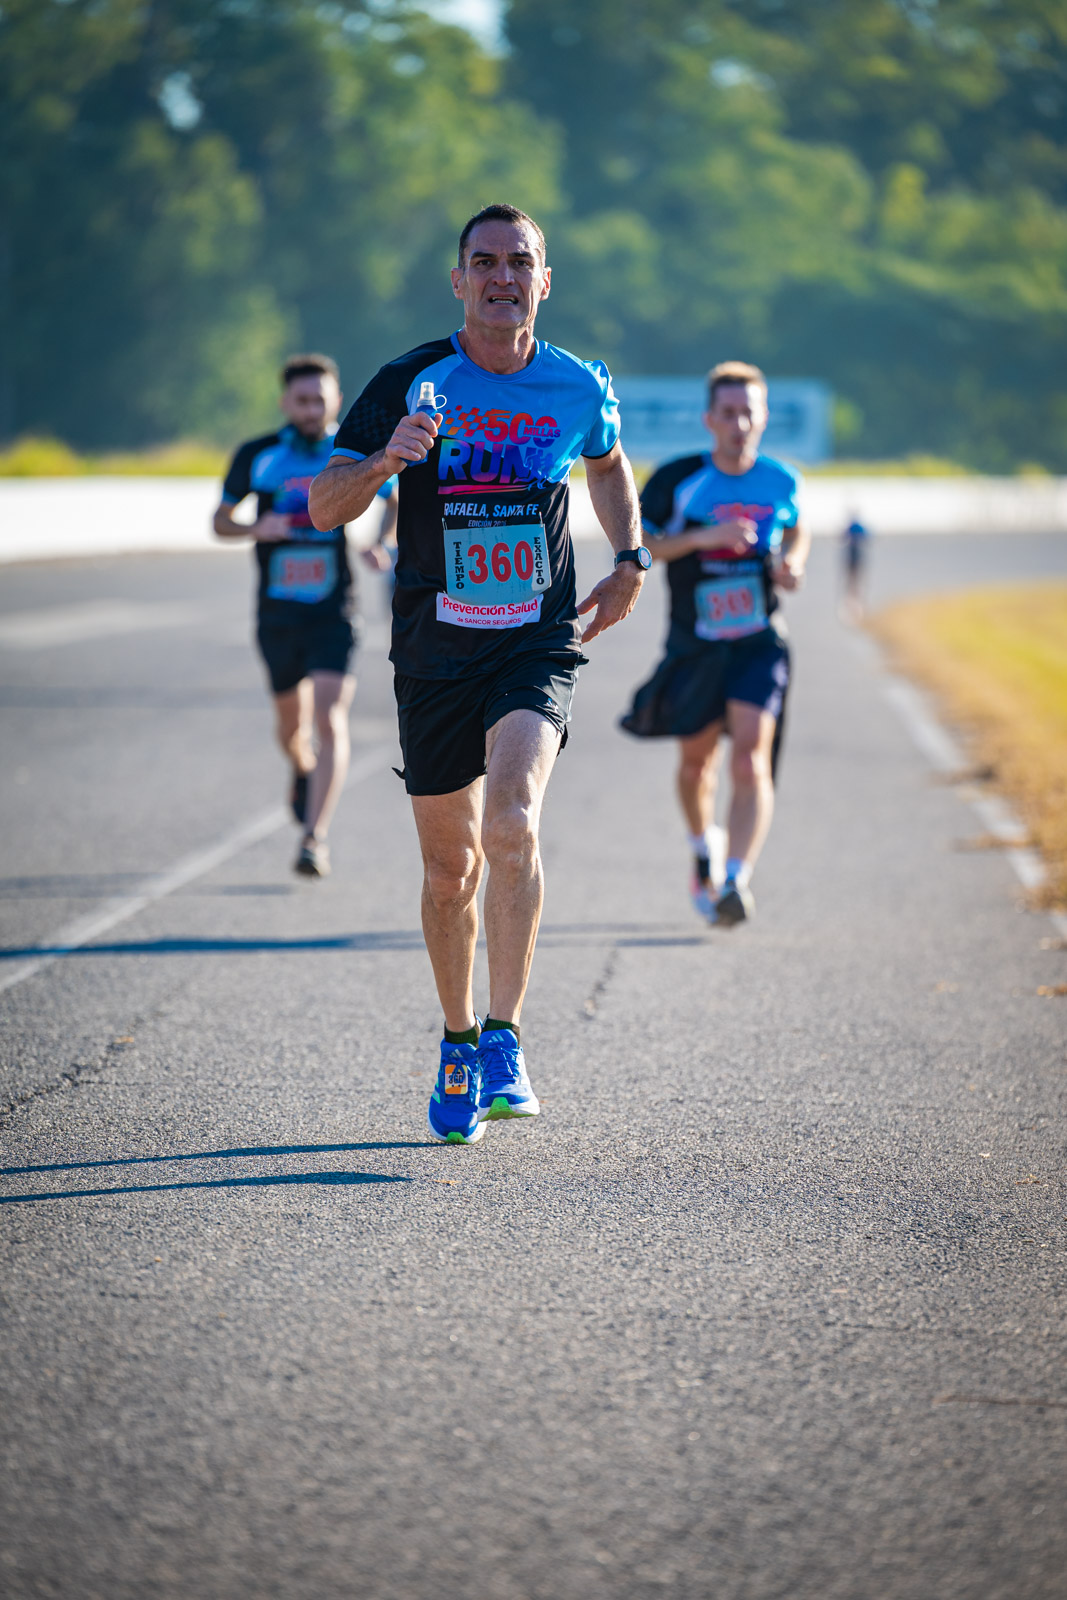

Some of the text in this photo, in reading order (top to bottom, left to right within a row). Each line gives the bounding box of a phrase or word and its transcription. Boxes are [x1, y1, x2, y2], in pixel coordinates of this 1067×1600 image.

[484, 408, 558, 448] 500
[523, 427, 561, 438] MILLAS
[438, 438, 537, 484] RUN
[444, 502, 539, 518] RAFAELA, SANTA FE
[453, 541, 464, 589] TIEMPO
[467, 540, 534, 584] 360
[533, 537, 545, 585] EXACTO
[442, 597, 538, 616] Prevención Salud
[465, 617, 491, 625] SANCOR
[492, 617, 522, 625] SEGUROS
